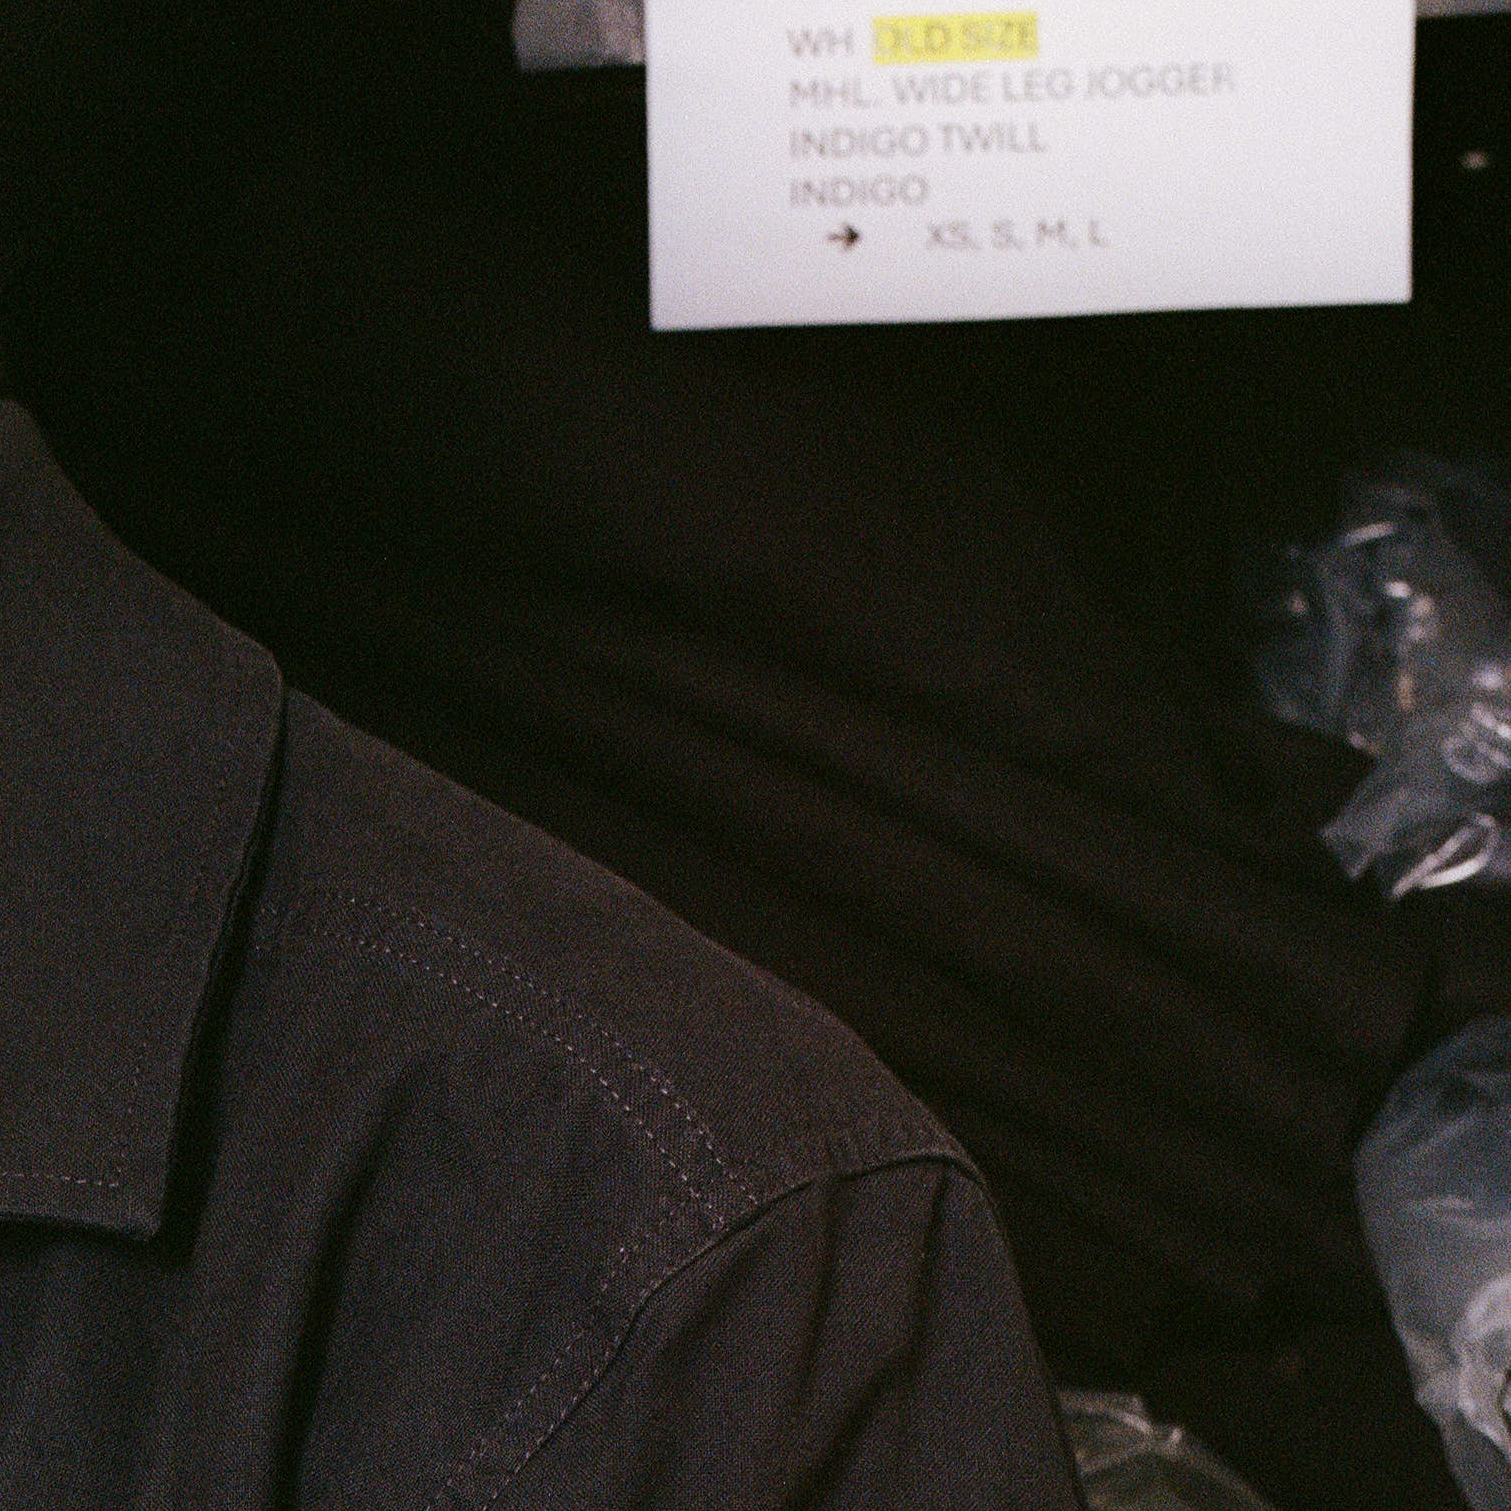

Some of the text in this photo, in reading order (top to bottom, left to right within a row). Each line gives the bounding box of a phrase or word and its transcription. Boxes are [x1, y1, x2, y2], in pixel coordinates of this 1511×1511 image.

[786, 25, 855, 59] WH
[788, 62, 1239, 110] MHL. WIDE LEG JOGGER
[788, 121, 1049, 160] INDIGO TWILL
[788, 174, 931, 209] INDIGO
[1088, 217, 1111, 249] L
